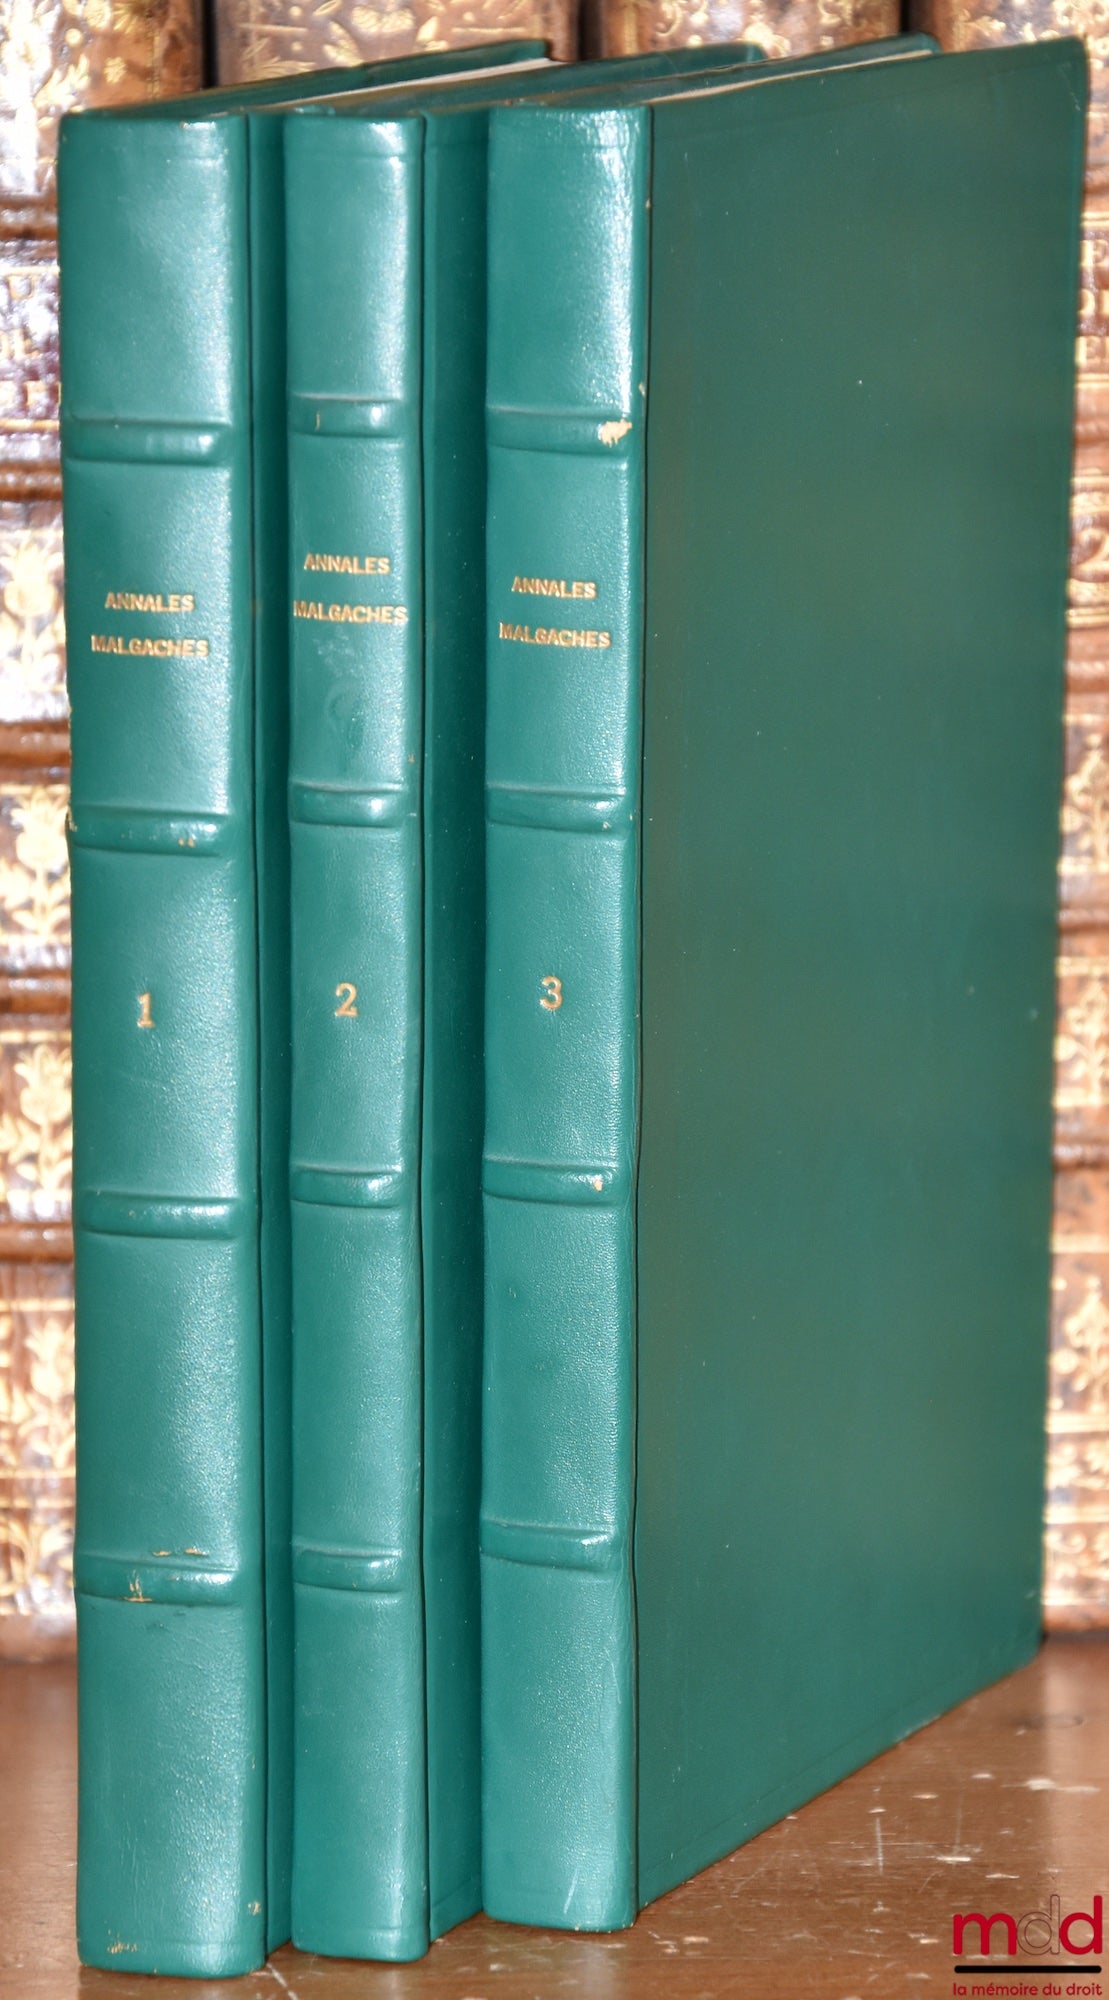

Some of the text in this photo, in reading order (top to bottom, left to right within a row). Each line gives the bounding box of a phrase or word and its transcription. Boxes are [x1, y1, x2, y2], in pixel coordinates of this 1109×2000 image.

[303, 553, 390, 576] ANNALES
[511, 576, 597, 600] ANNALES
[104, 591, 195, 613] ANNALES
[293, 600, 409, 625] MALGACHES
[91, 634, 209, 658] MALGACHES
[499, 621, 611, 649] MALGACHES
[334, 982, 358, 1017] 2
[540, 976, 563, 1010] 3
[136, 991, 154, 1028] 1
